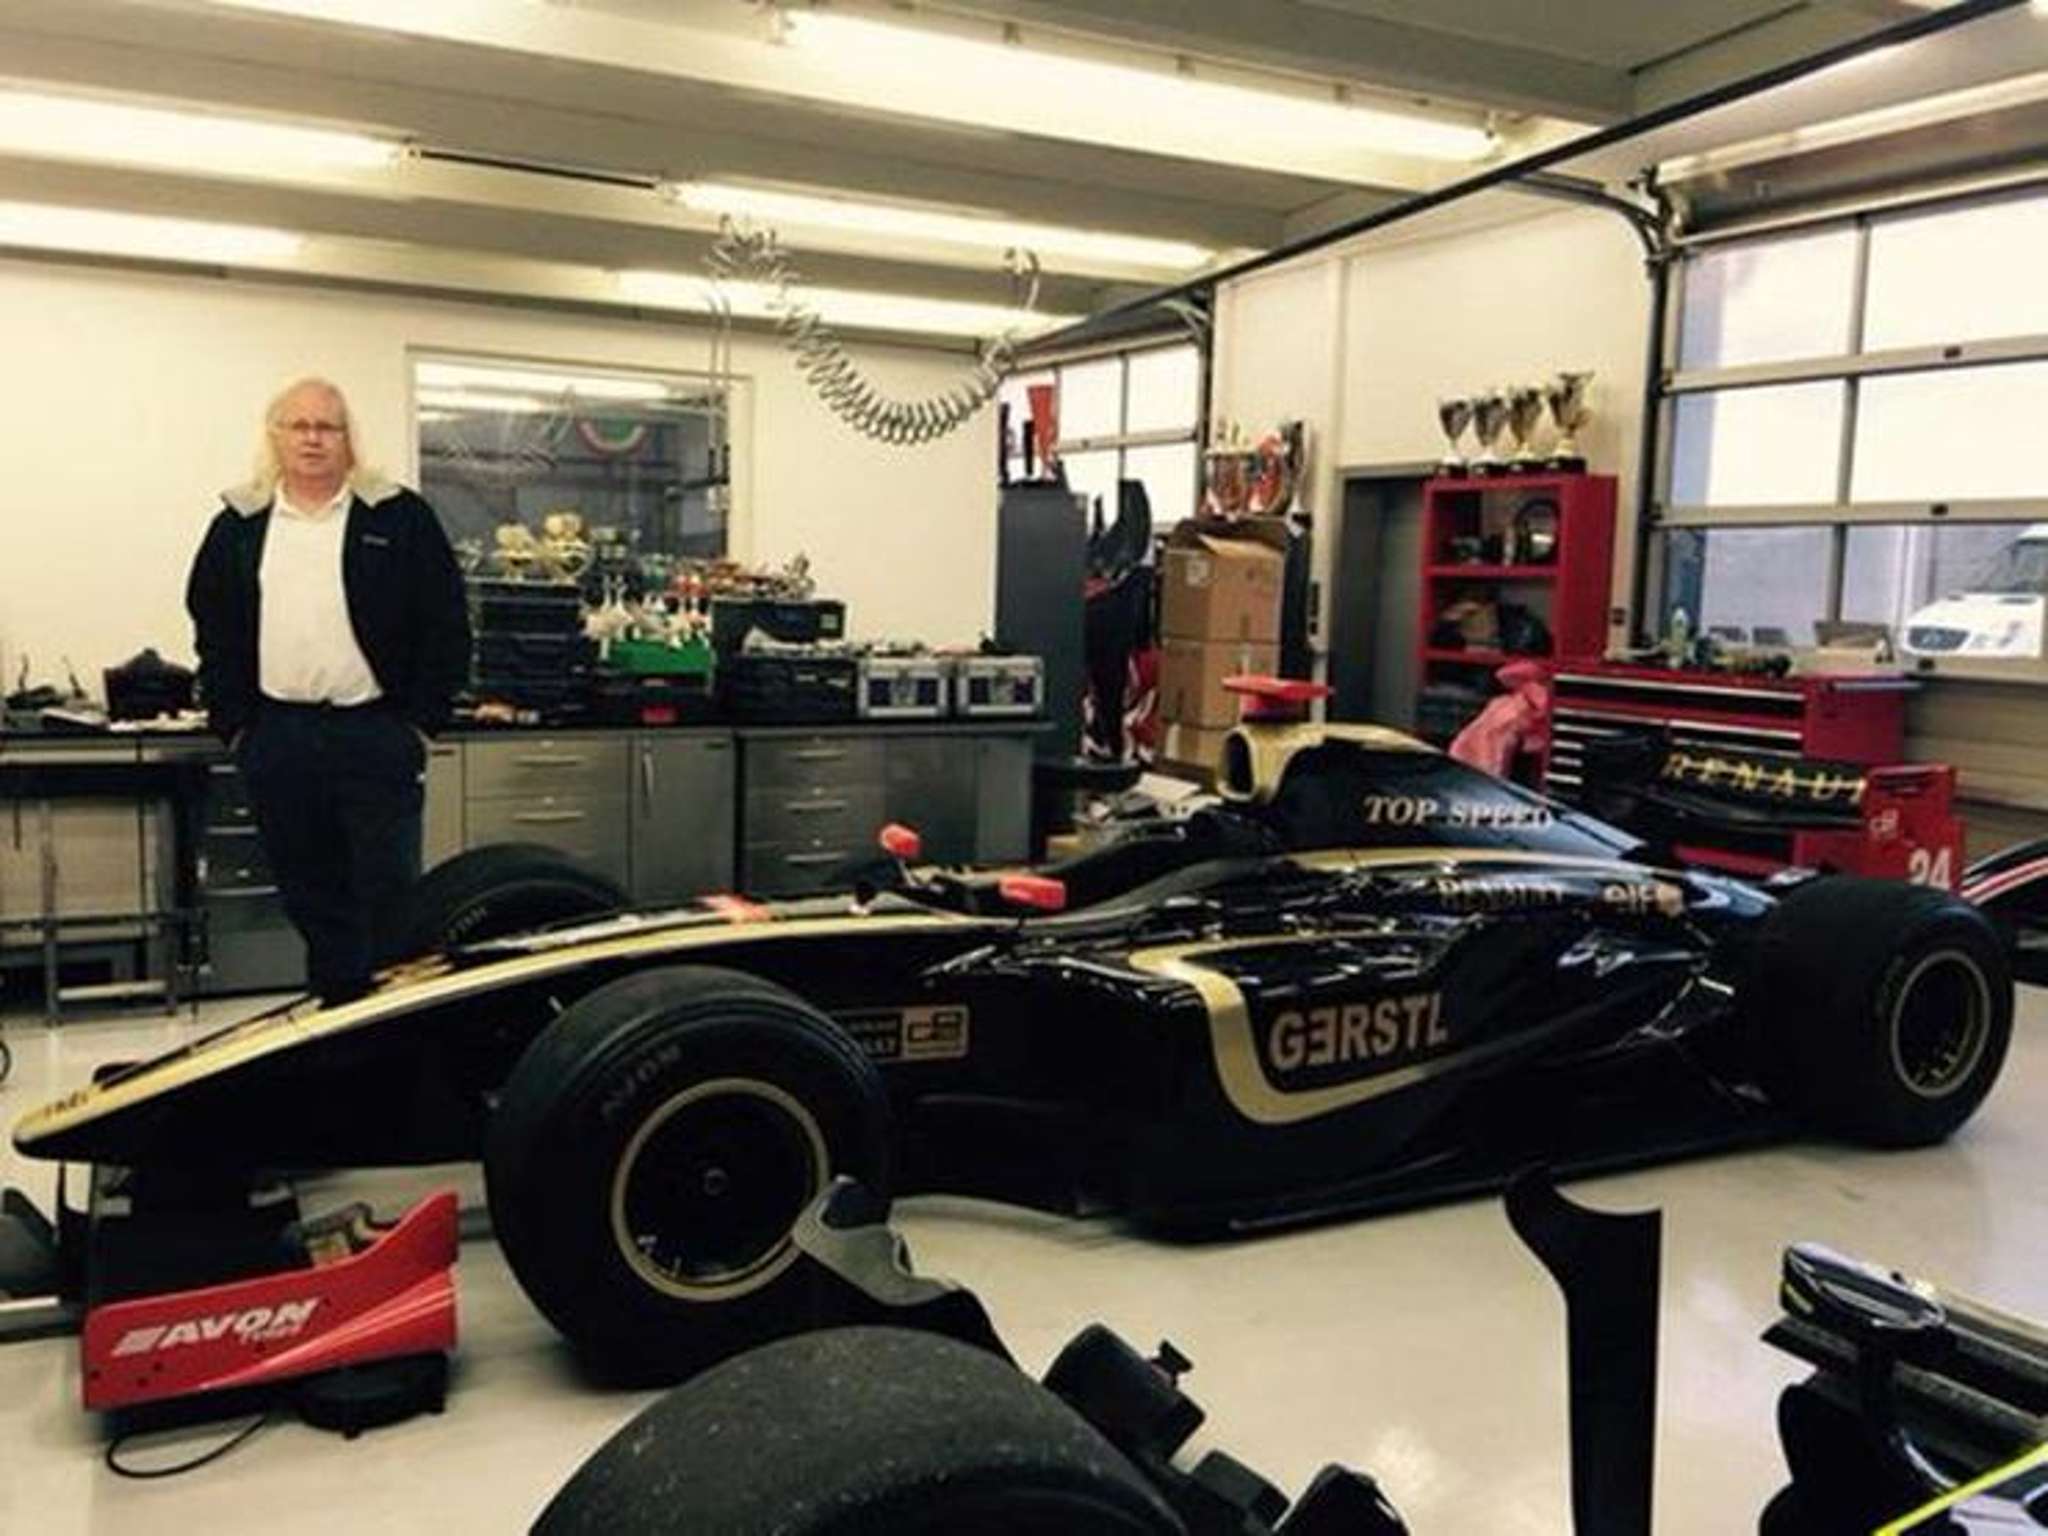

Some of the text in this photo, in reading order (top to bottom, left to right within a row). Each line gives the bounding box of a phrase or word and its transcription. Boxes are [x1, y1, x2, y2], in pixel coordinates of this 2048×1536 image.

[1364, 796, 1552, 831] TOP SPEED
[1268, 992, 1448, 1070] GERSTL
[157, 1297, 320, 1349] AVON
